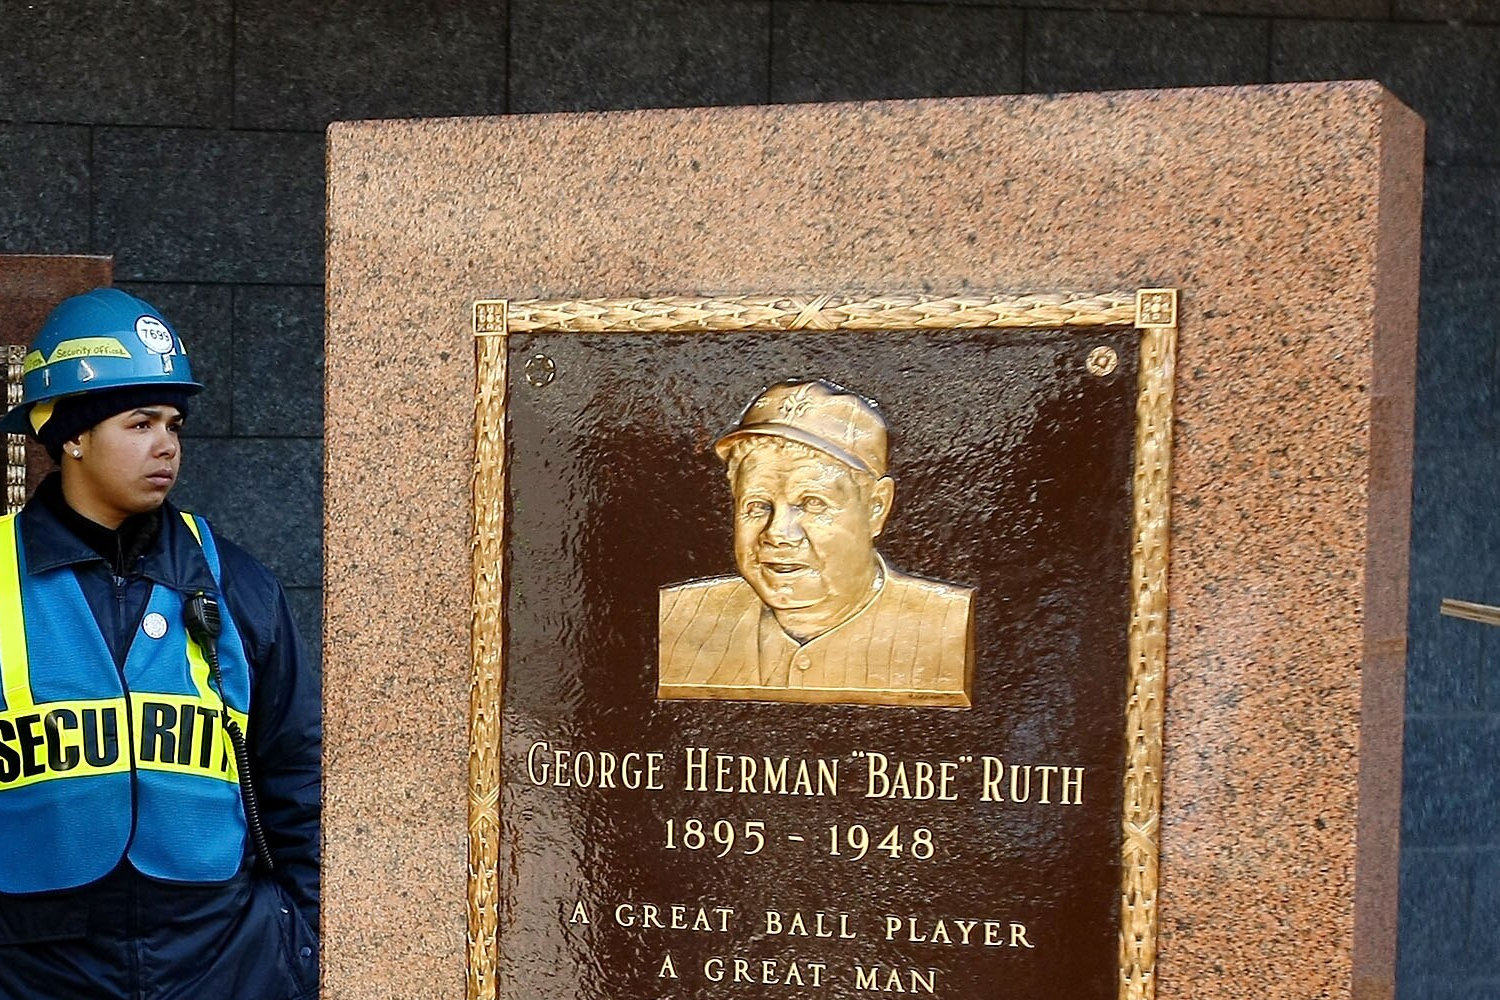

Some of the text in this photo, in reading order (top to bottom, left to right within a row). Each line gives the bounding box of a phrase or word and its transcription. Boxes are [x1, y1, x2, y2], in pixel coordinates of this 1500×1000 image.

[141, 329, 169, 341] 7699
[527, 741, 665, 791] GEORGE
[684, 747, 839, 797] HERMAN
[981, 757, 1085, 805] RUTH
[665, 818, 766, 857] 1895
[830, 823, 936, 861] 1948
[570, 901, 1035, 948] A GREAT BALL PLAYER
[658, 957, 938, 995] A GREAT MAN
